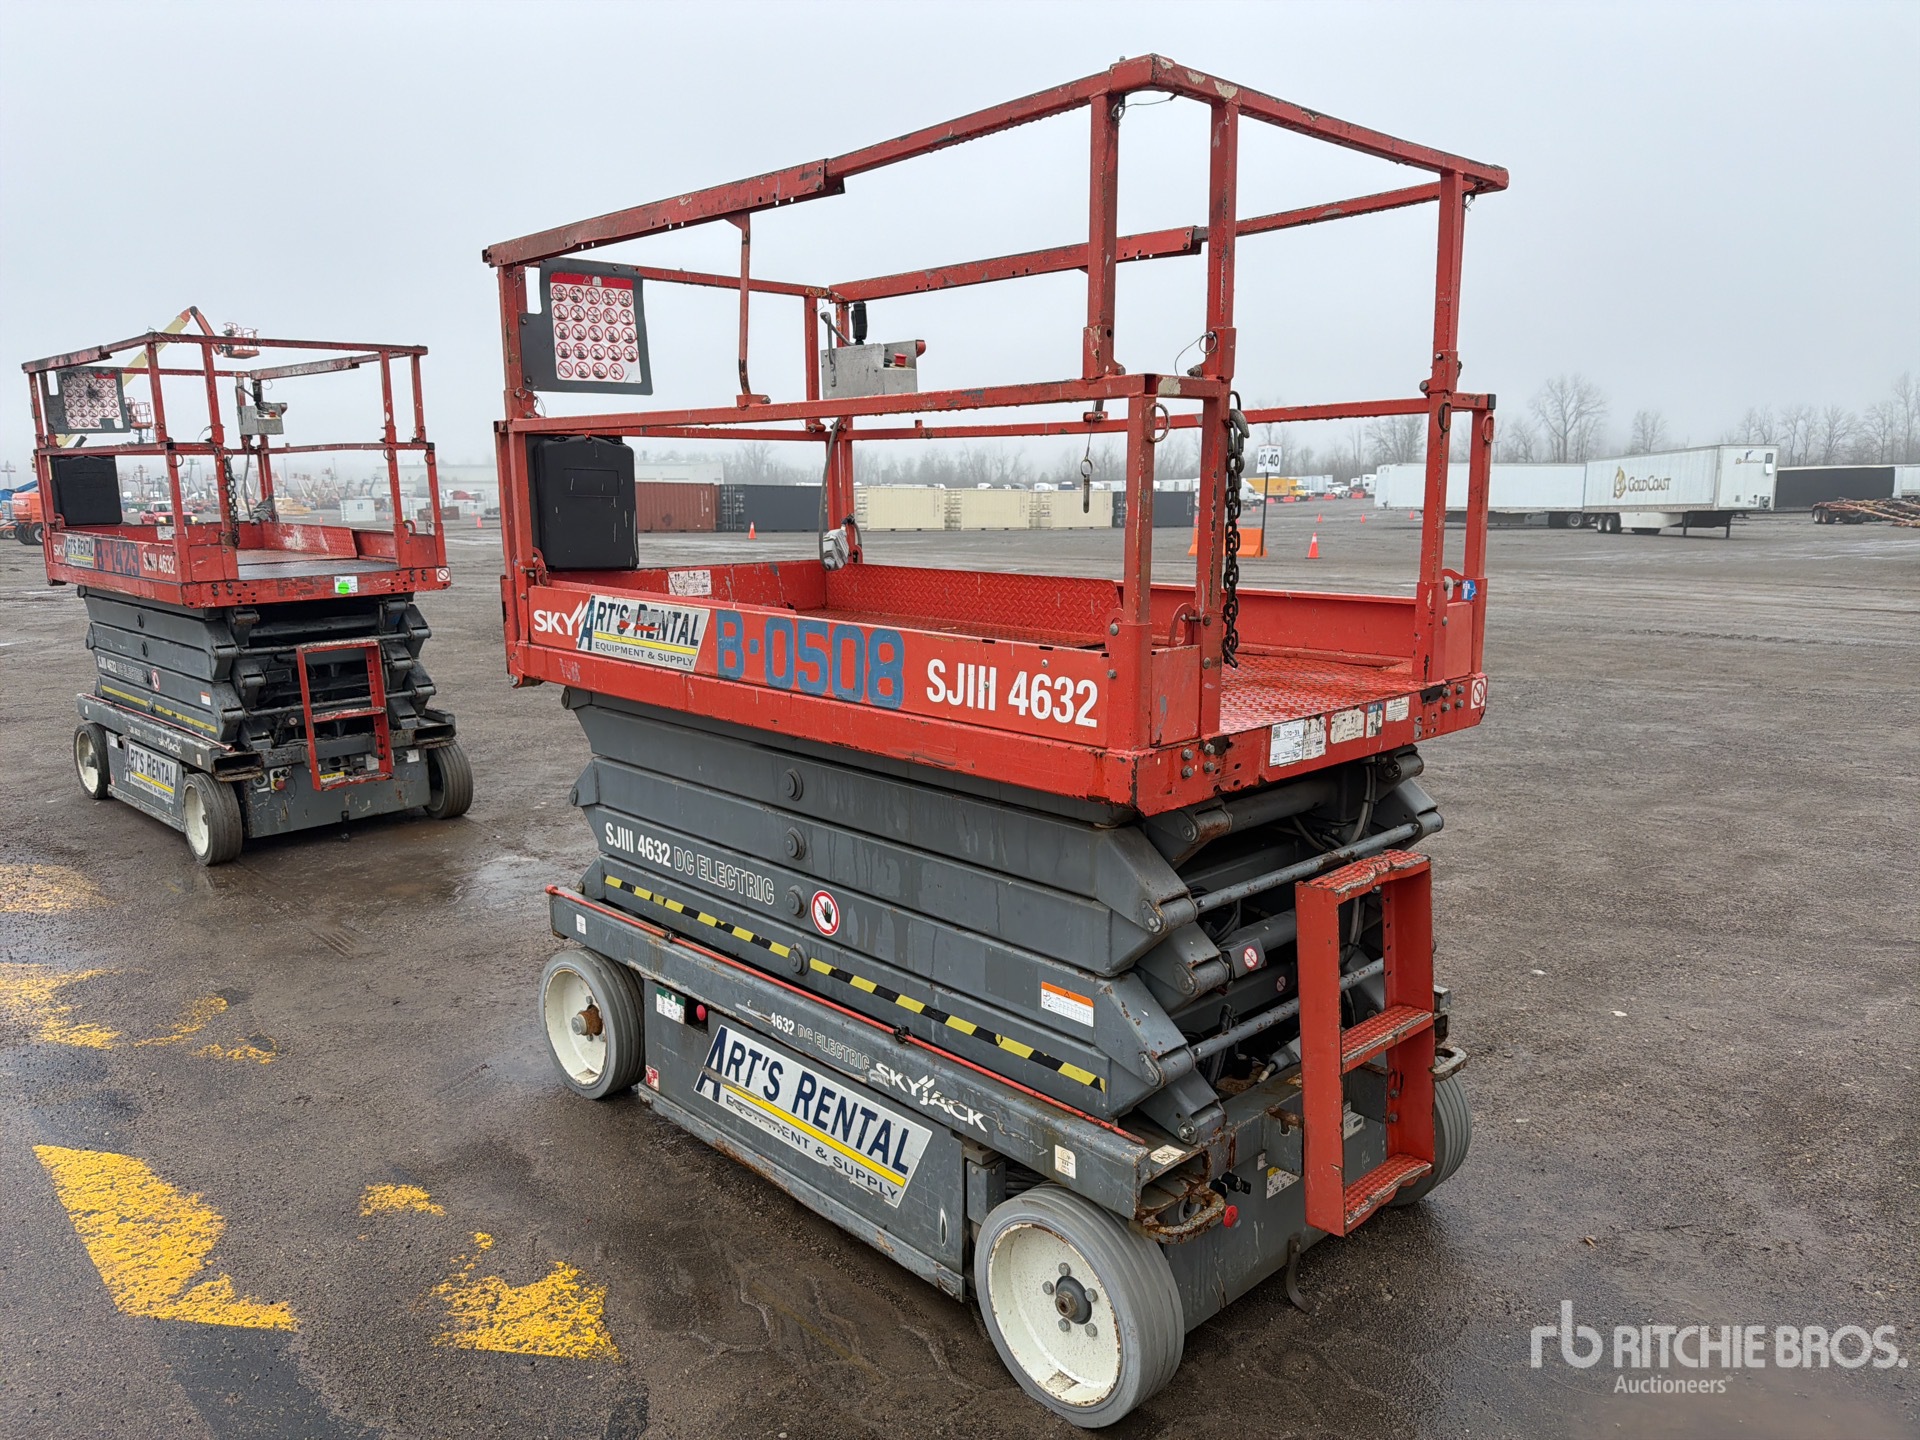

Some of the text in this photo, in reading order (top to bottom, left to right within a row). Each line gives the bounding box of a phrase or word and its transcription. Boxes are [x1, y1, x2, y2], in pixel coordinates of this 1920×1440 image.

[1268, 454, 1280, 467] 40
[158, 554, 176, 575] 4632
[577, 595, 699, 651] ART'S RENTAL
[595, 642, 694, 667] EQUIPMENT & SUPPLY
[926, 658, 1098, 728] SJIII 4632
[147, 754, 174, 788] RENTAL
[605, 821, 775, 906] SJIII 4632 DC ELECTRIC
[770, 1012, 795, 1036] 4632
[814, 1031, 870, 1070] ELECTRIC
[695, 1026, 910, 1175] ART'S RENTAL
[875, 1062, 988, 1133] SKYJACK
[815, 1146, 828, 1161] &
[832, 1155, 899, 1200] SUPPLY
